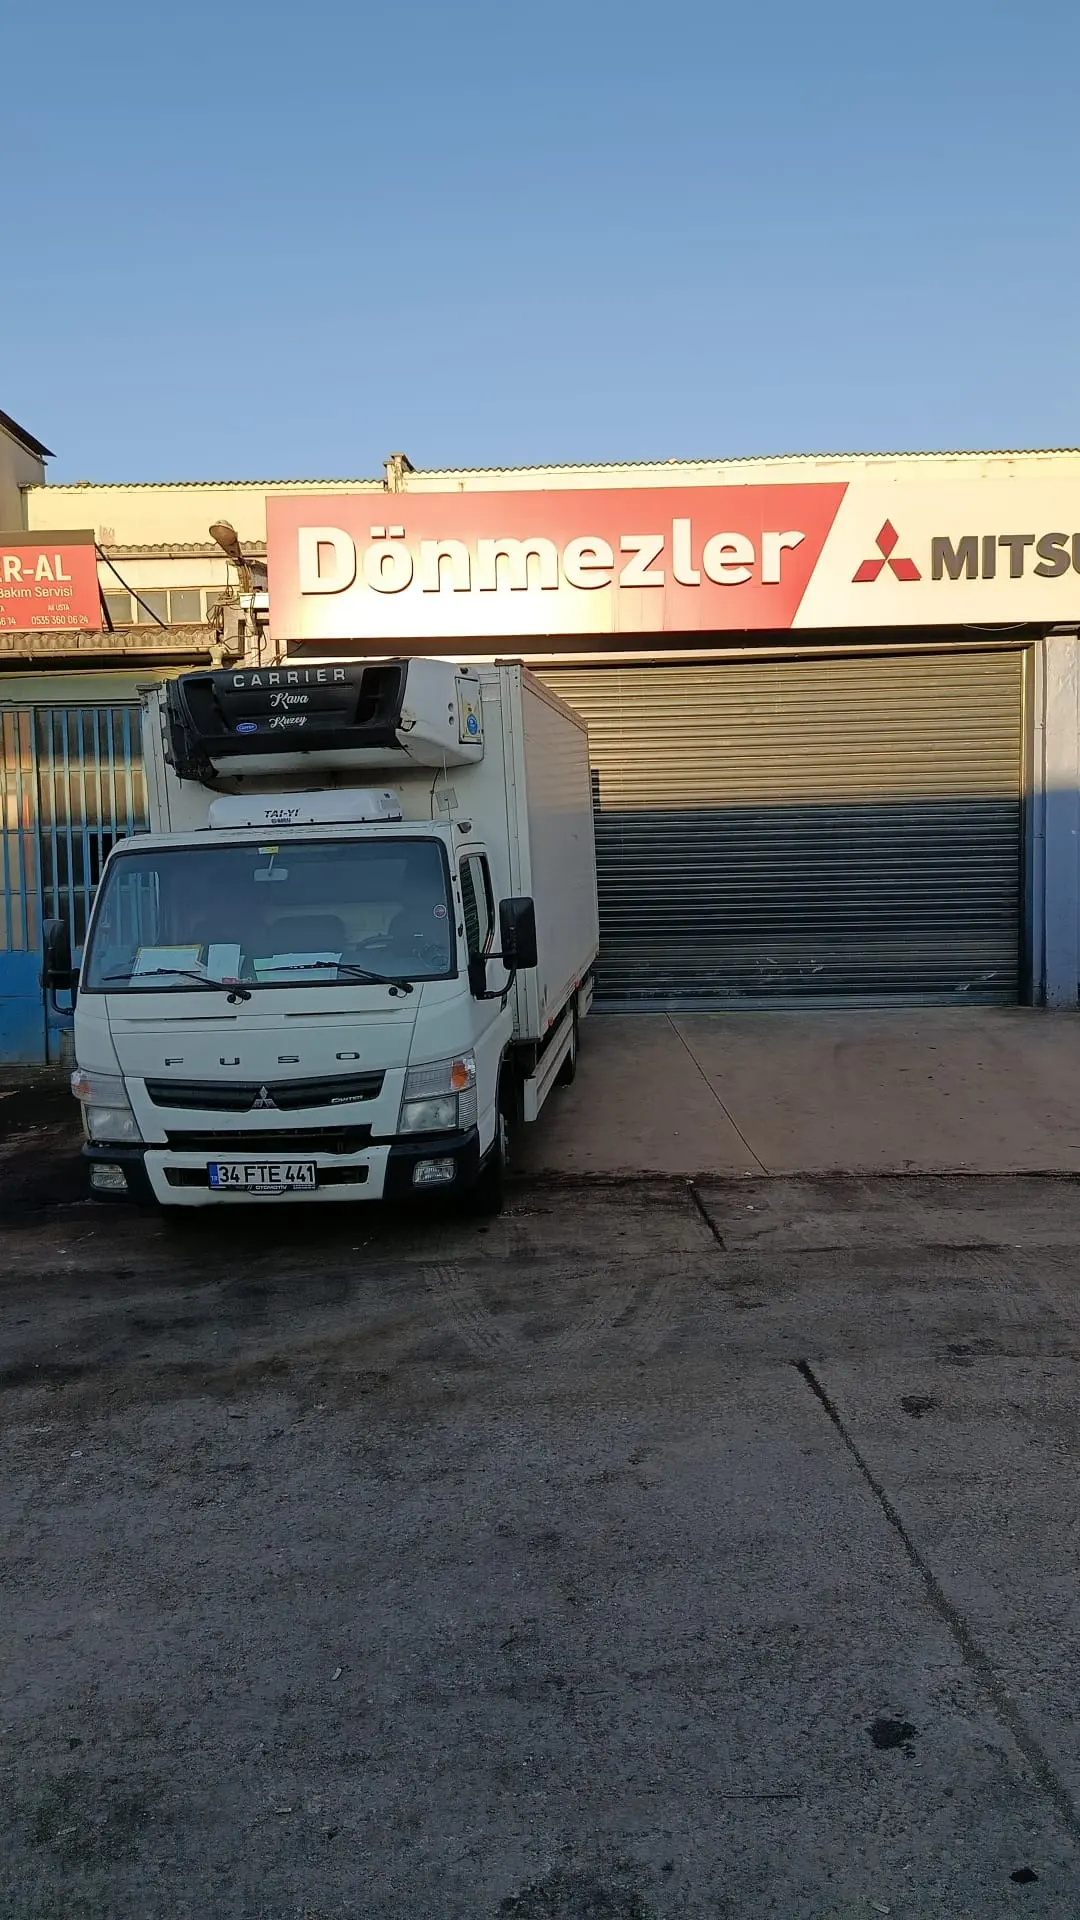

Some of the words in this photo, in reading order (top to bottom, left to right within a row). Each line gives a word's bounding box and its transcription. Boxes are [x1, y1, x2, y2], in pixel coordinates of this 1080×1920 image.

[297, 517, 806, 595] Dönmezler
[931, 532, 1080, 581] MITS
[0, 554, 72, 583] R-AL
[34, 586, 73, 598] Servisi
[31, 616, 50, 625] 0535
[233, 668, 346, 688] CARRIER
[270, 692, 309, 710] Kava
[268, 715, 308, 730] Kuzey
[264, 808, 300, 818] TAI-YI
[164, 1052, 360, 1066] FUSO
[219, 1166, 240, 1183] 34
[243, 1165, 282, 1183] FTE
[285, 1164, 314, 1182] 441
